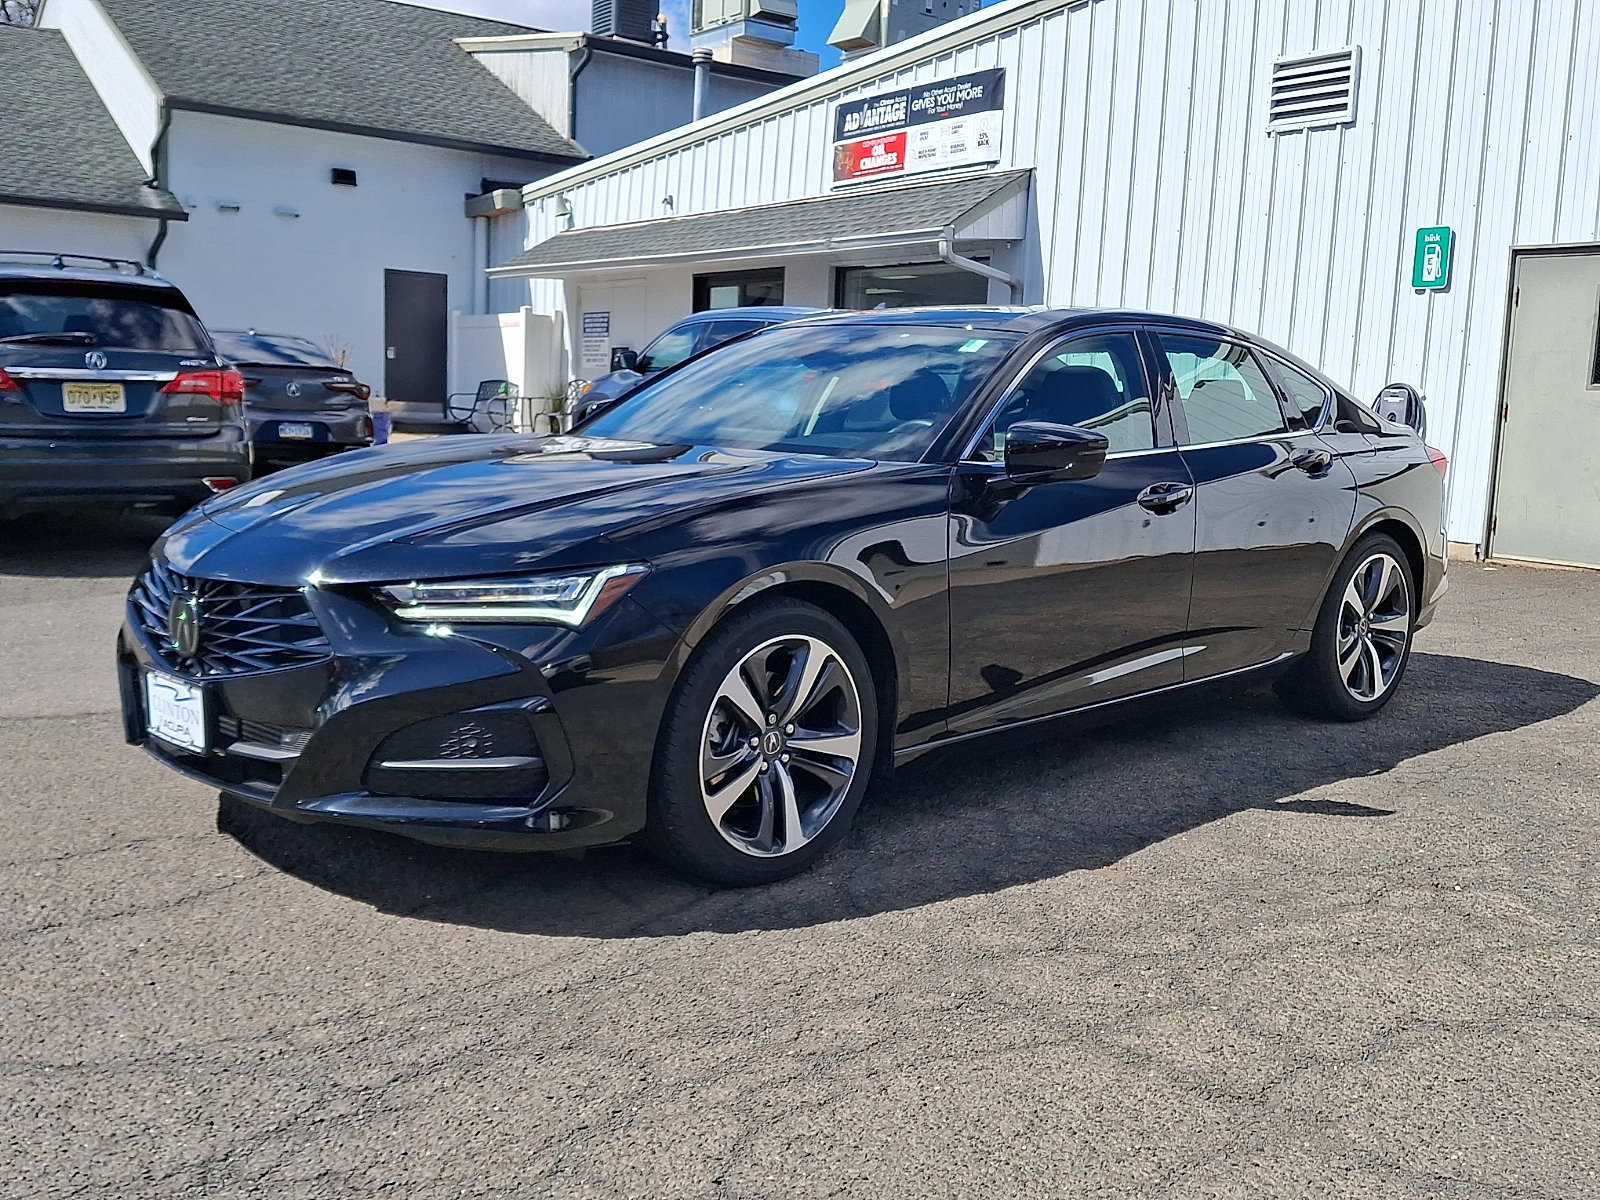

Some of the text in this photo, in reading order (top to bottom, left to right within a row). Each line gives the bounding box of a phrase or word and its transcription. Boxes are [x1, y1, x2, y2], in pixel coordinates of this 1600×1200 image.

[912, 86, 983, 111] GIVES YOU MORE
[844, 102, 906, 131] ADVANTAGE
[872, 144, 886, 156] OIL
[860, 152, 898, 170] CHANGES
[1424, 233, 1441, 242] blink
[153, 694, 199, 725] CLINTON
[163, 719, 191, 737] ACURA
